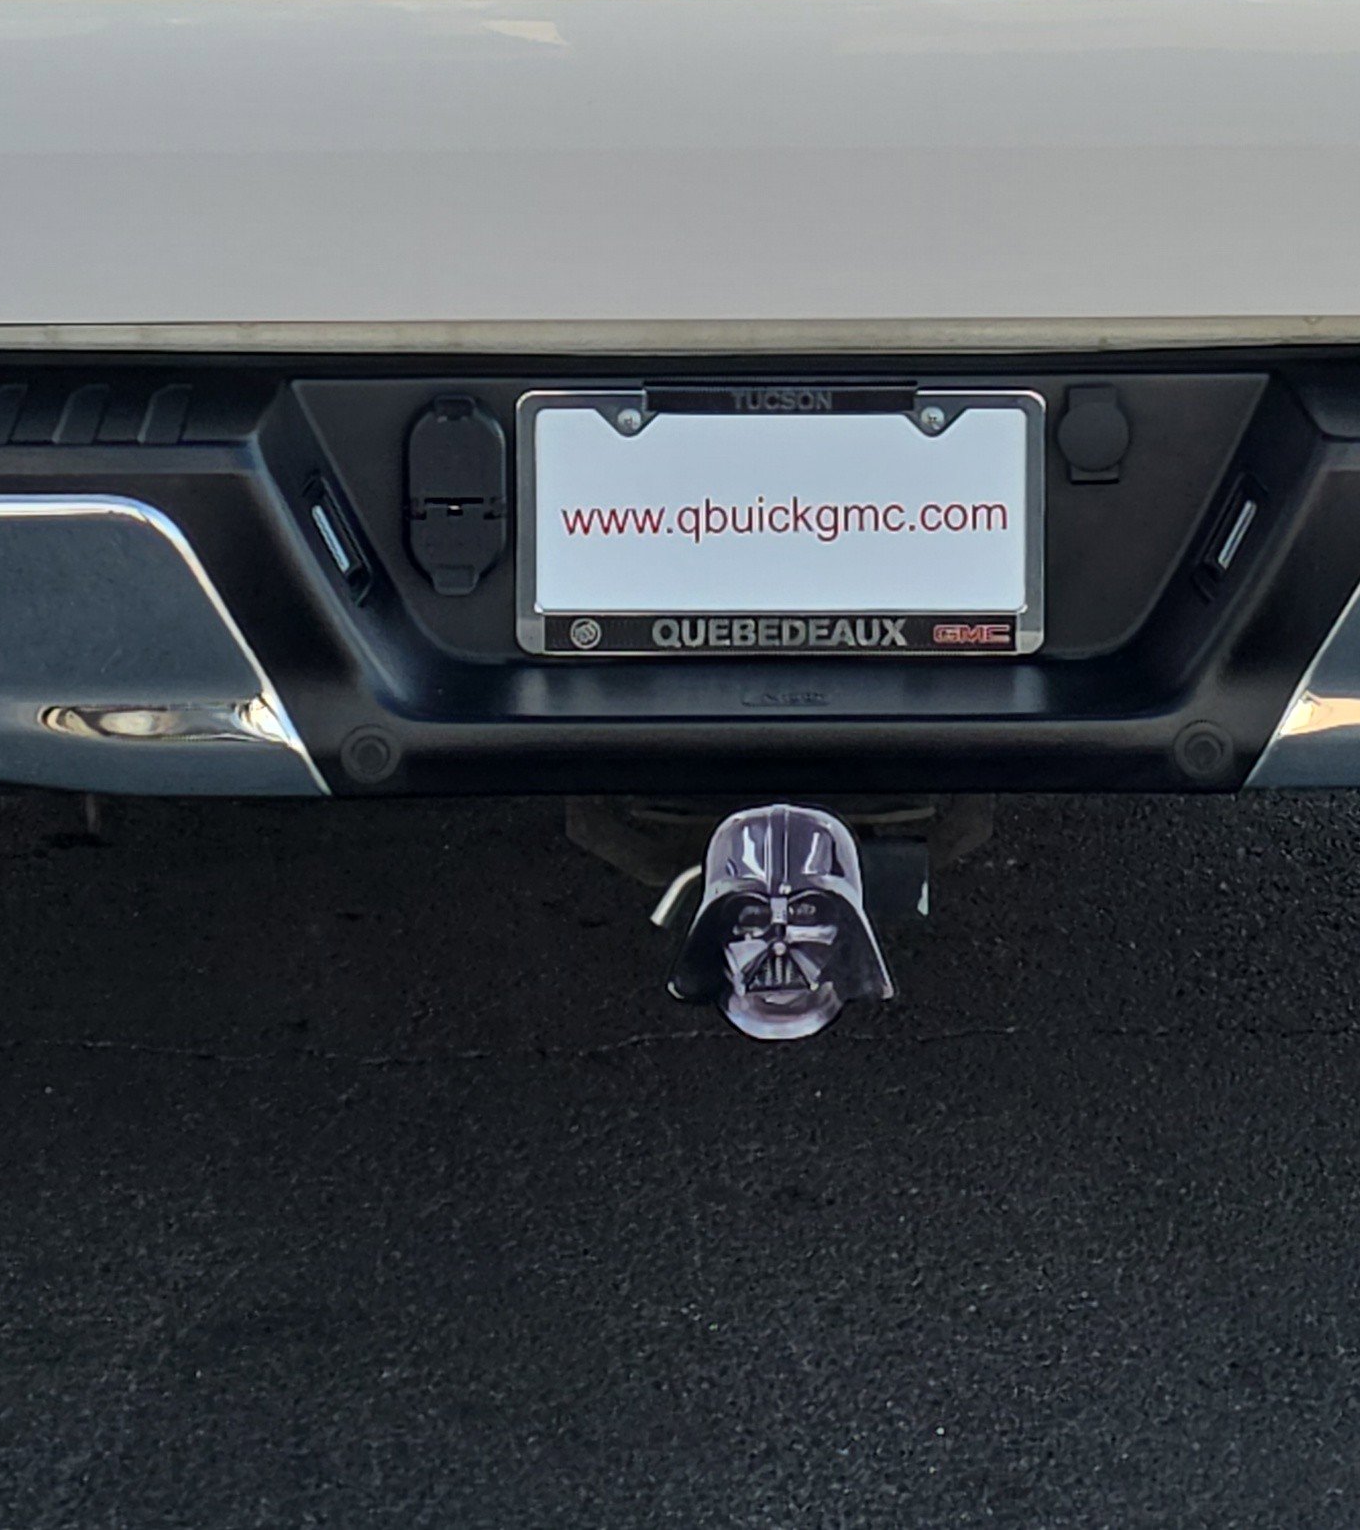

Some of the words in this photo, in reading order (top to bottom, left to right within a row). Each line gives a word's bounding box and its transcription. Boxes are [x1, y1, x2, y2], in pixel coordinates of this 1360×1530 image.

[732, 390, 834, 411] TUCSON
[561, 496, 1009, 543] www.qbuickgmc.com
[652, 618, 908, 648] QUEBEDEAUX
[933, 624, 1010, 643] GMC
